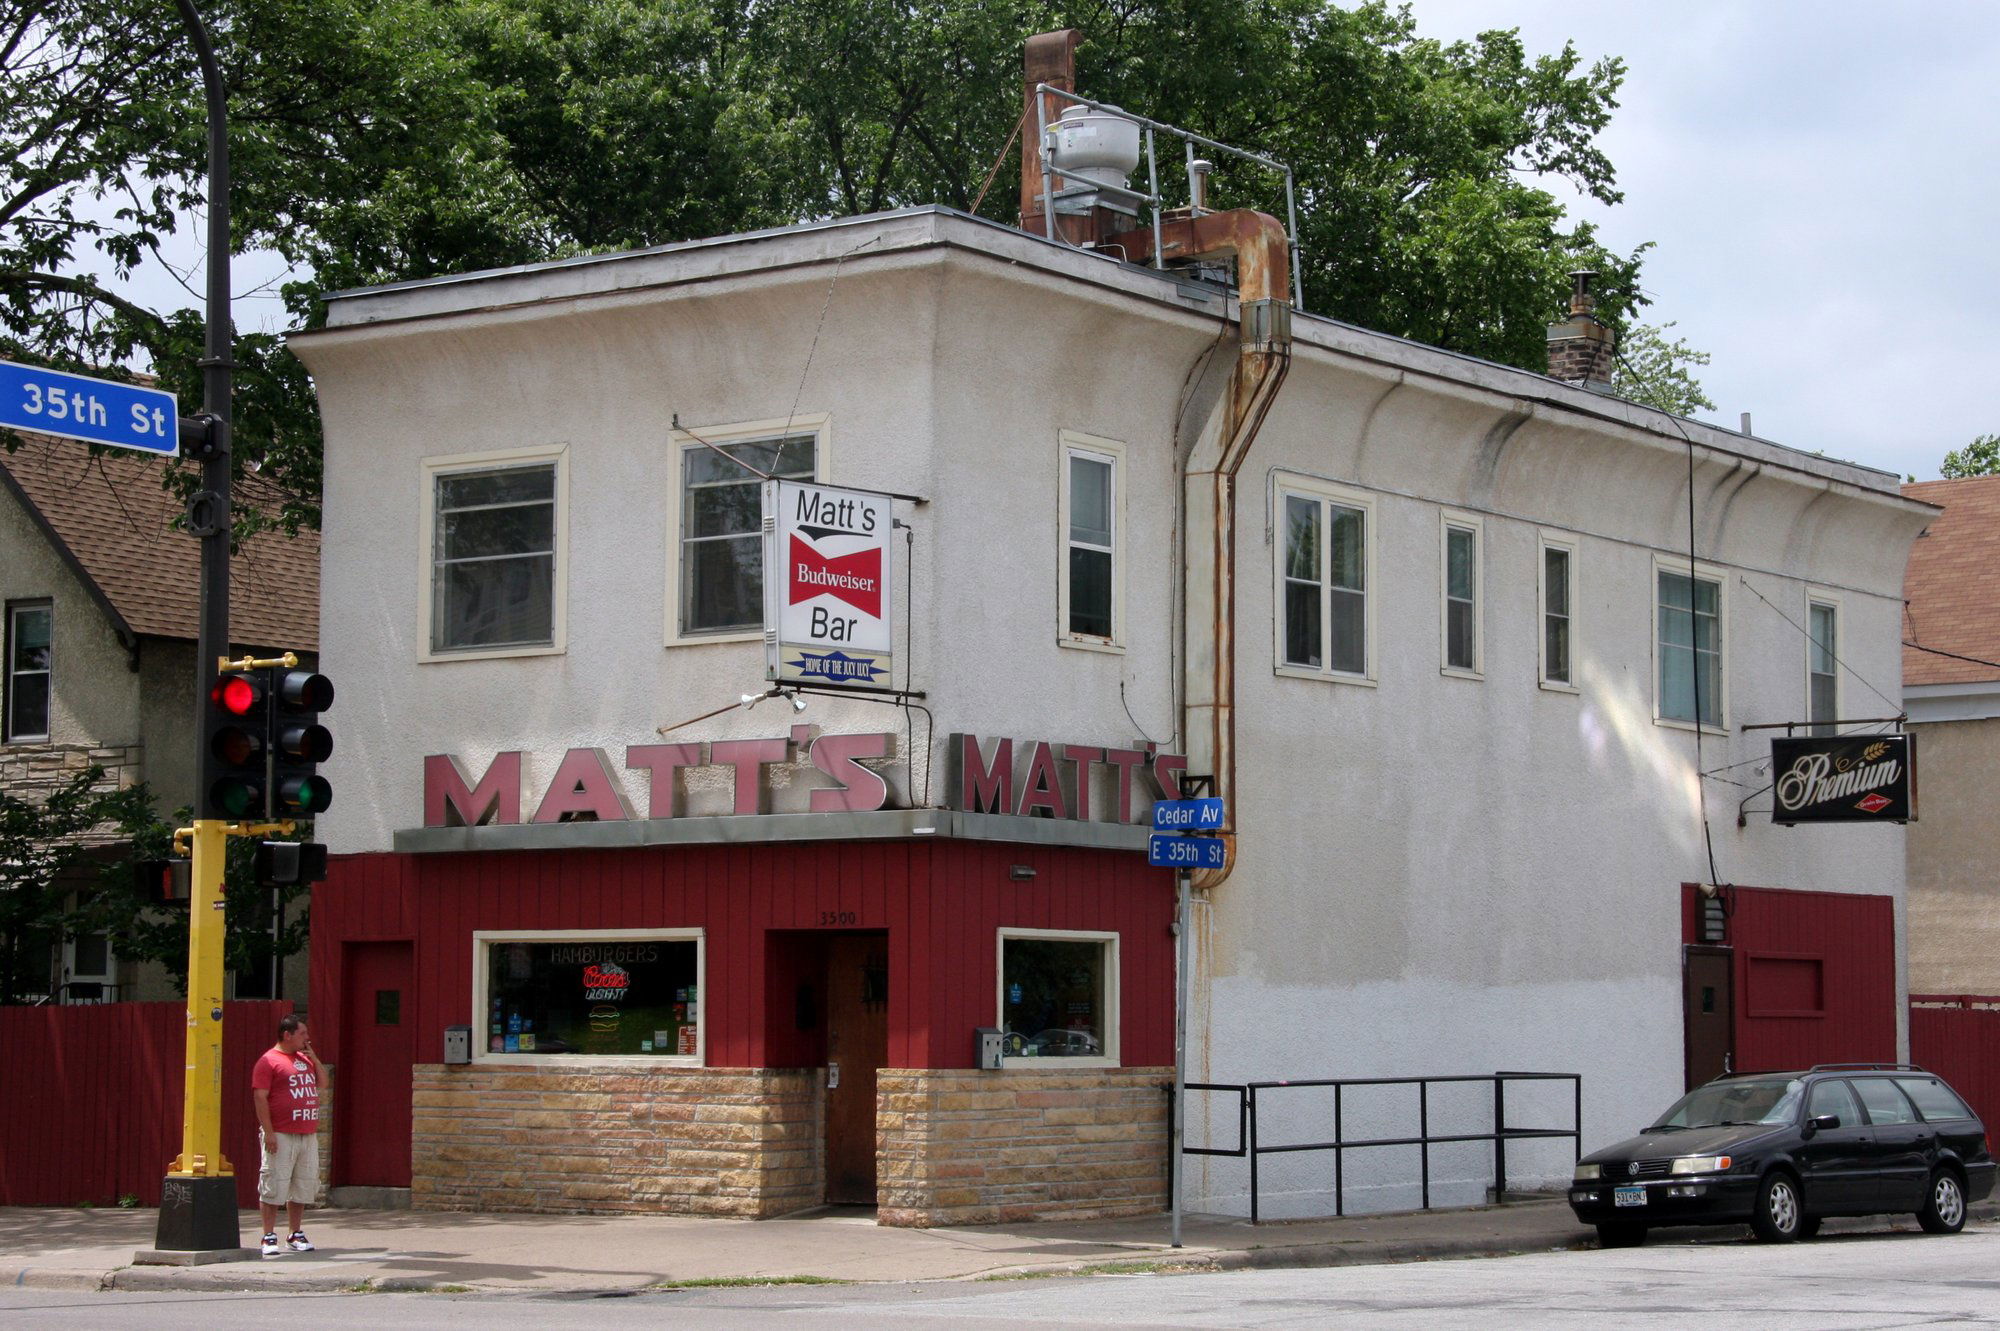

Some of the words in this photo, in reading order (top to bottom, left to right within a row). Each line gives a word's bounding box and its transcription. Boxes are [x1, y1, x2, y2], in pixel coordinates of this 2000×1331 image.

[22, 383, 107, 427] 35th
[130, 402, 166, 437] St
[796, 489, 876, 532] Matt's
[797, 563, 875, 592] Budweiser
[810, 606, 858, 642] Bar
[805, 657, 822, 673] HOME
[822, 659, 831, 674] OF
[832, 660, 842, 675] THE
[424, 724, 897, 828] MATT'S
[1777, 752, 1902, 811] Premium
[1156, 806, 1195, 825] Cedar
[1200, 804, 1220, 823] Av
[1152, 841, 1161, 860] E
[1167, 842, 1199, 862] 35th
[1208, 845, 1221, 863] St
[820, 911, 857, 926] 3500
[551, 944, 658, 963] HAMBURGERS
